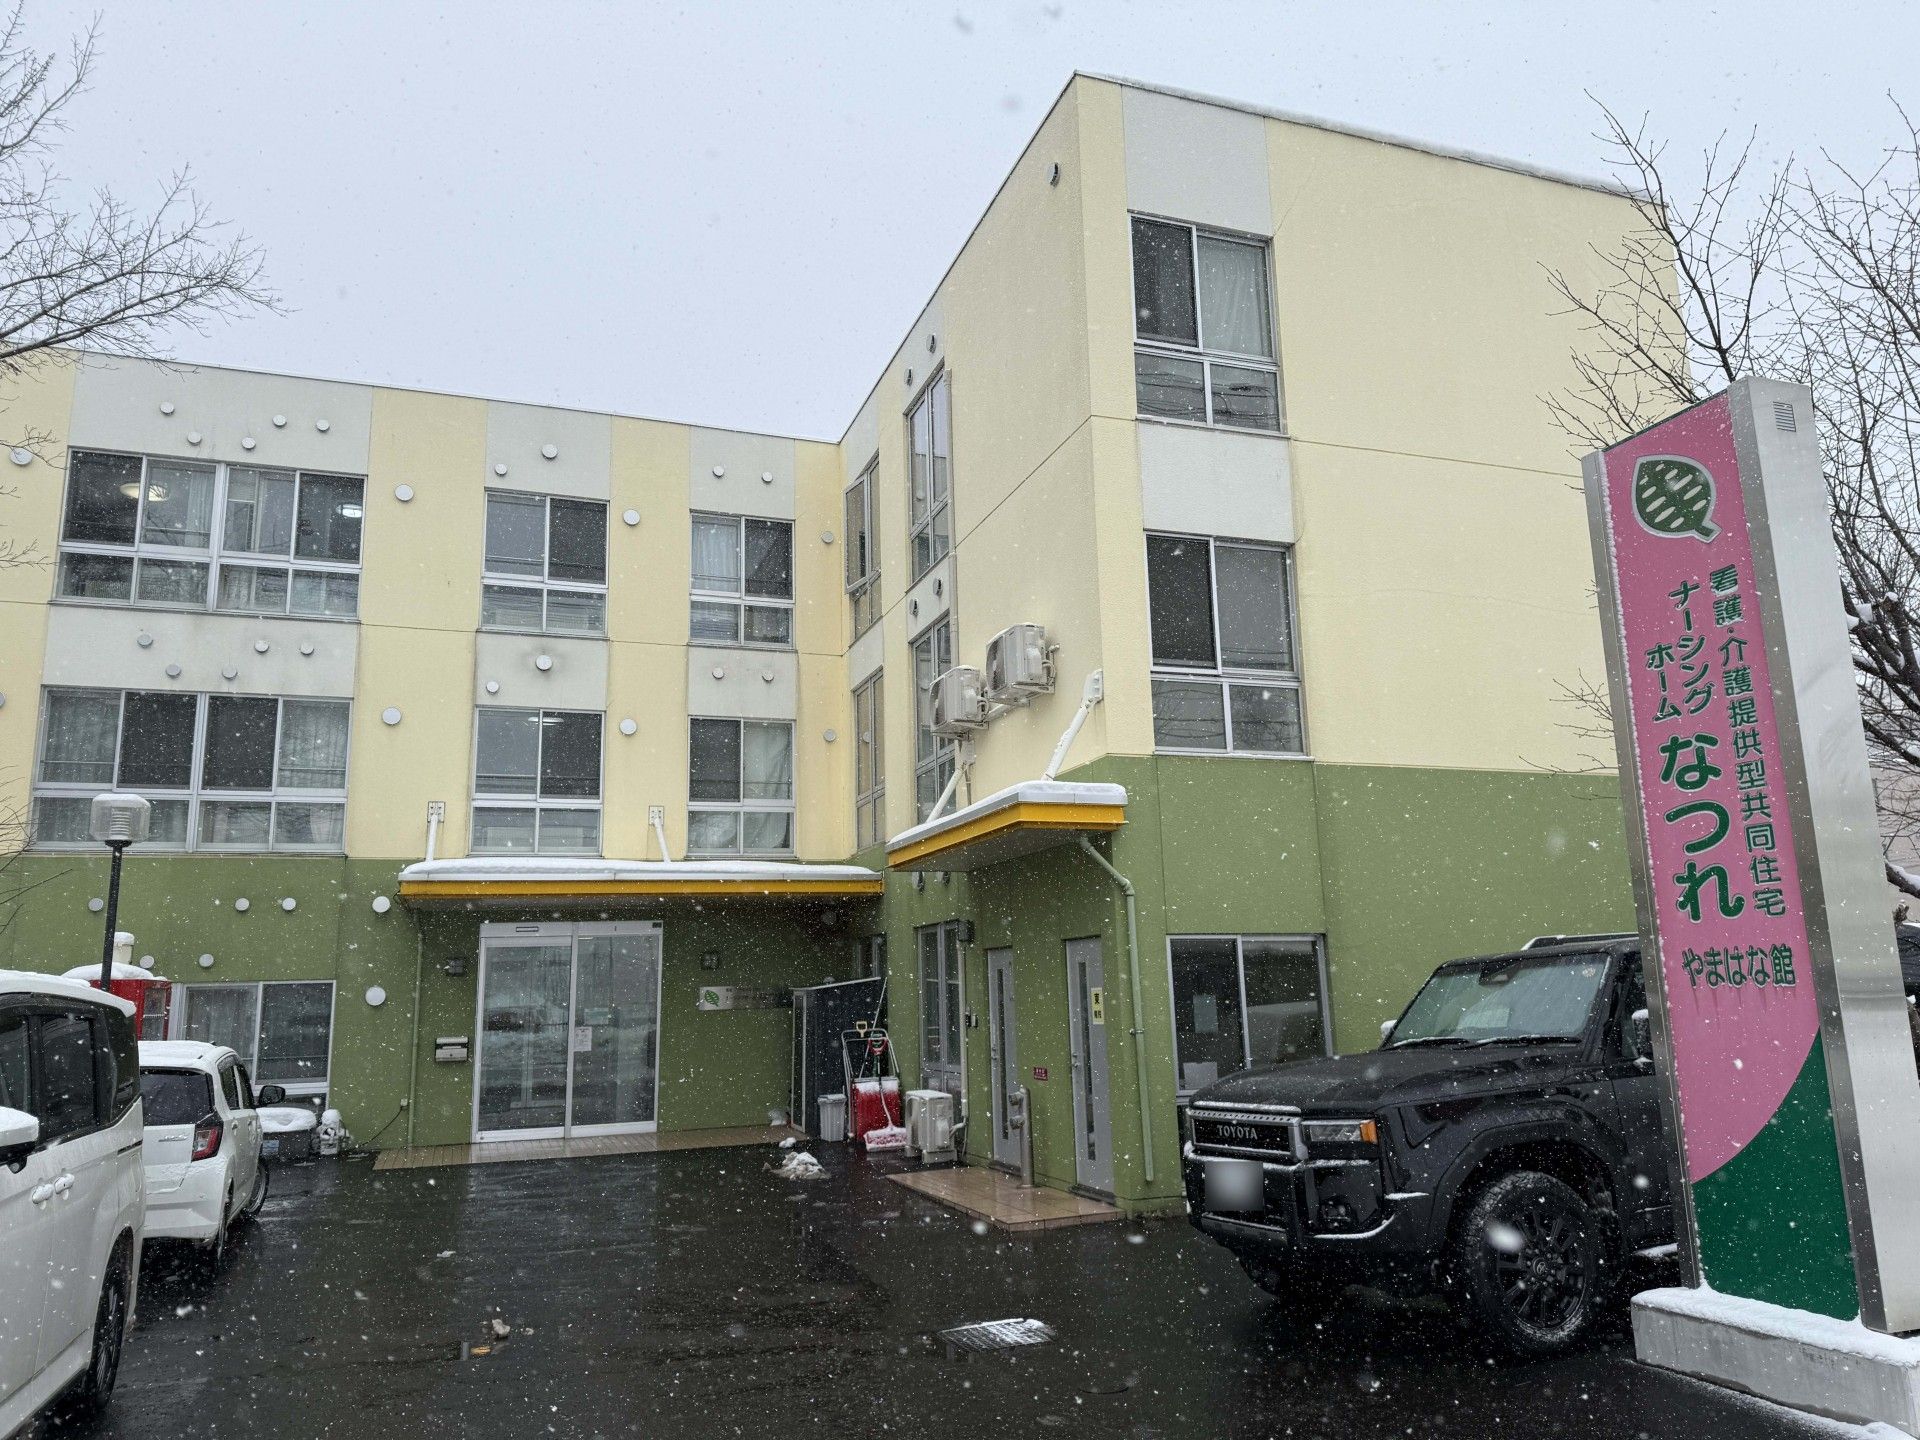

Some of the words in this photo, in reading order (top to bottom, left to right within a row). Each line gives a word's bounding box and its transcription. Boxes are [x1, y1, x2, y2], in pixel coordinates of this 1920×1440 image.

[1646, 642, 1683, 722] ホーム
[1669, 580, 1715, 715] ナーシング
[1710, 564, 1786, 917] 看護・介護提供型共同住宅
[1658, 734, 1745, 923] なつれ
[1681, 943, 1796, 988] やまはな館
[1217, 1124, 1258, 1140] TOYOTA
